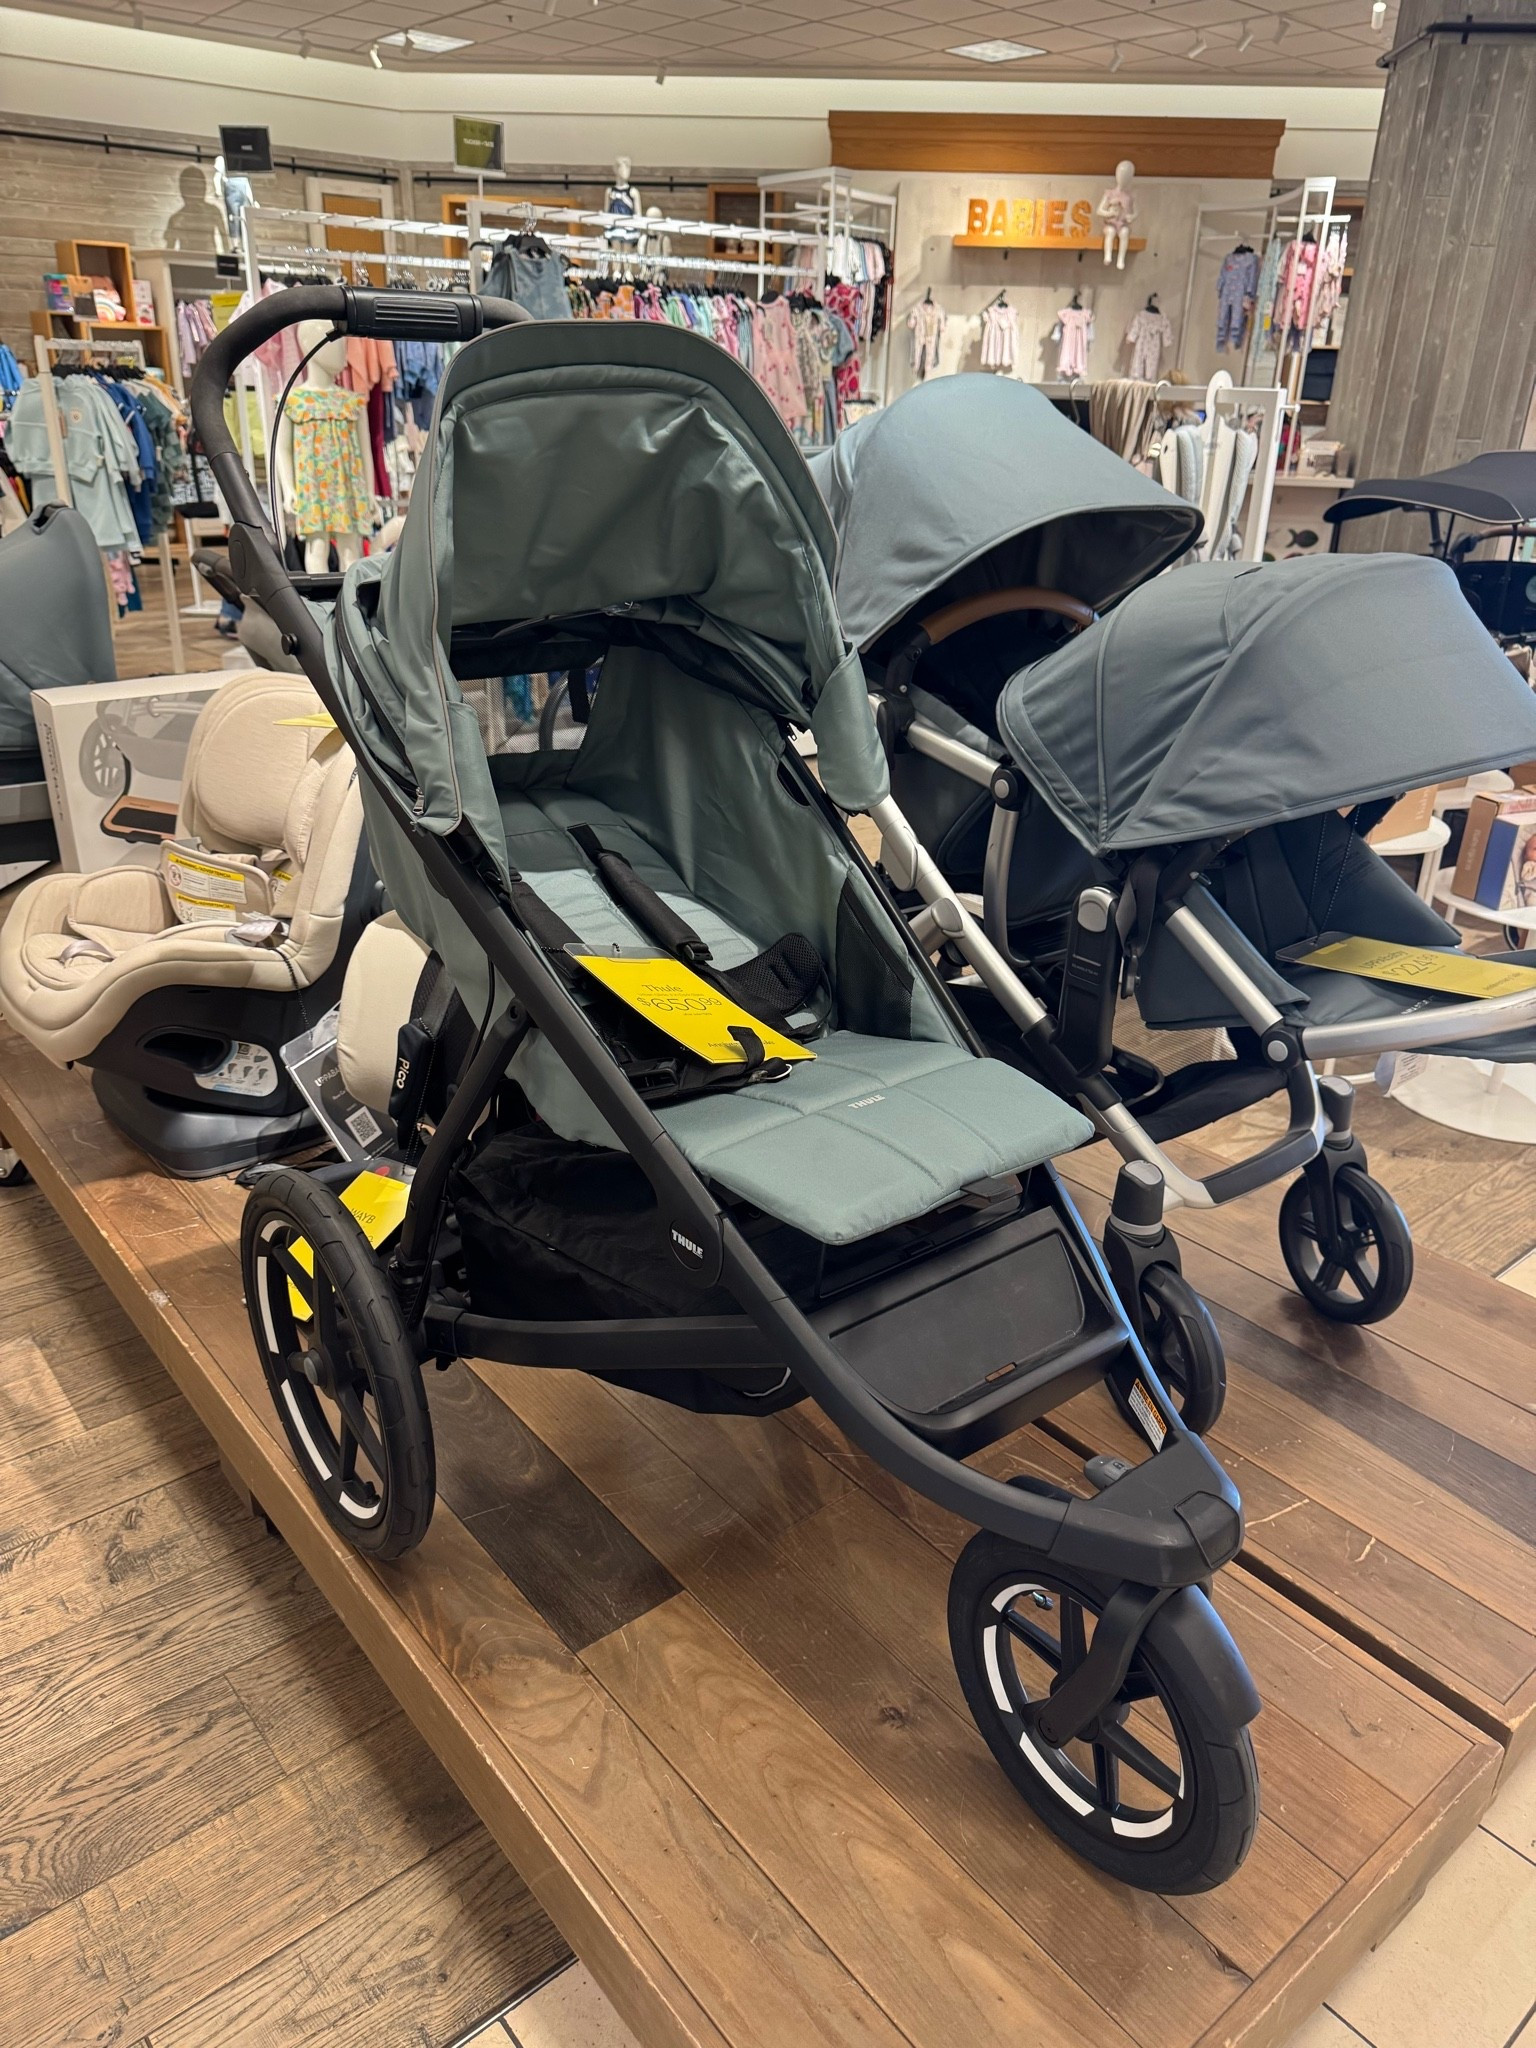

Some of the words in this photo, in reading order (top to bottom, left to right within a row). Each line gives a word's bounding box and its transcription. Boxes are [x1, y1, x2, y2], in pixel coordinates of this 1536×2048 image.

[968, 199, 1092, 237] BABIES
[641, 984, 683, 992] Thule
[847, 1094, 886, 1109] THULE
[350, 1208, 376, 1225] WAYB
[671, 1228, 704, 1256] THULE
